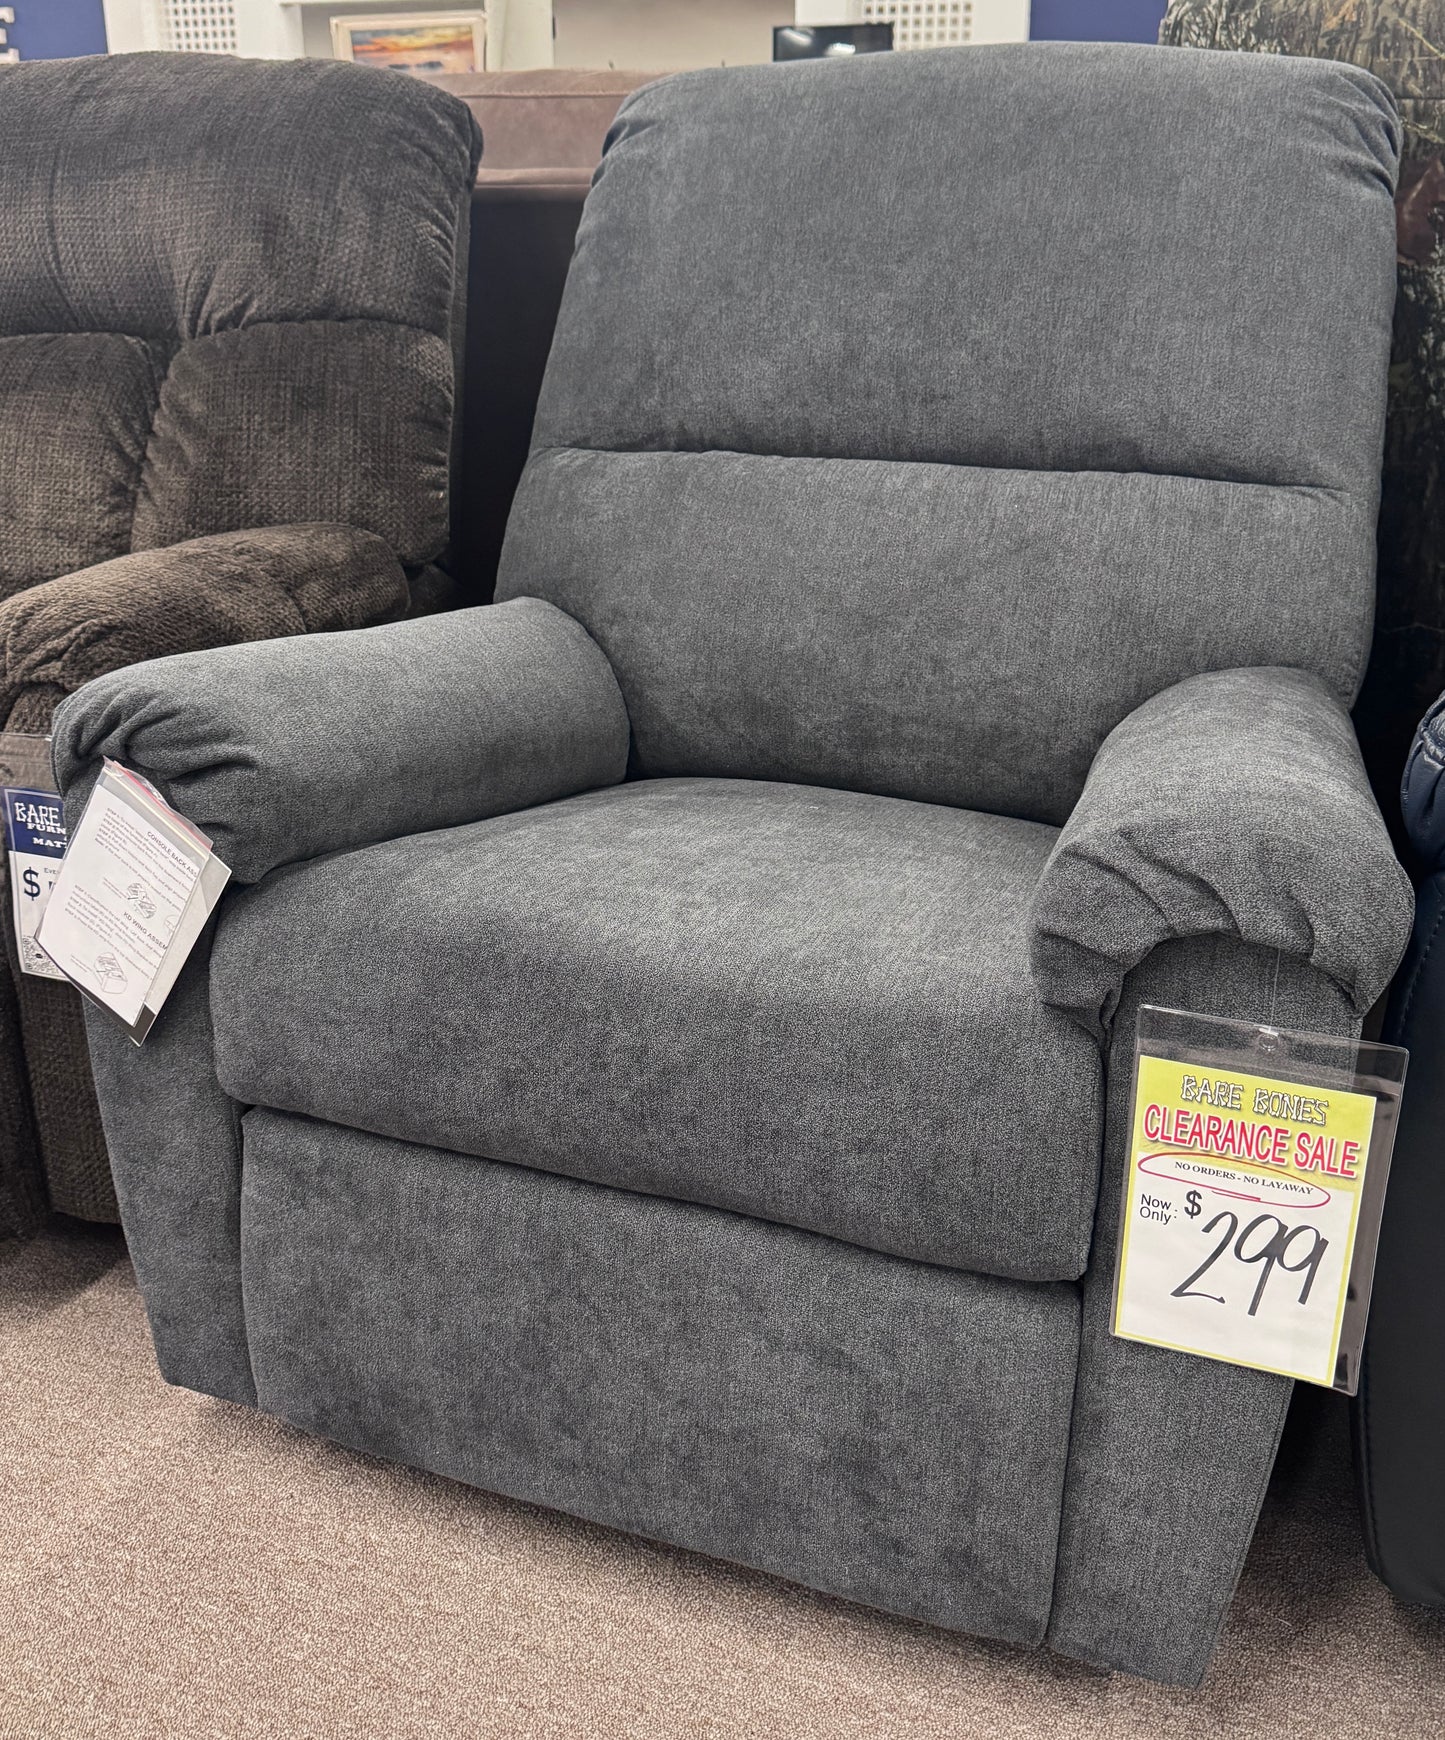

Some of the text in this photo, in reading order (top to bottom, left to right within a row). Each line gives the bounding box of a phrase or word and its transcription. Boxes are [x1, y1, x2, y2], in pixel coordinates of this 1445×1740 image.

[14, 801, 60, 827] BARE
[147, 831, 171, 856] CONSOLE
[171, 852, 187, 868] BACK
[22, 866, 41, 901] $
[124, 911, 133, 921] KD
[132, 919, 148, 934] WING
[1181, 1075, 1329, 1126] BARE BONES
[1144, 1104, 1360, 1177] CLEARANCE SALE
[1174, 1161, 1191, 1172] NO
[1192, 1165, 1236, 1181] ORDERS
[1243, 1174, 1260, 1185] NO
[1261, 1178, 1314, 1195] LAYAWAY
[1140, 1193, 1172, 1210] Now
[1184, 1190, 1203, 1219] $
[1170, 1211, 1330, 1316] 299
